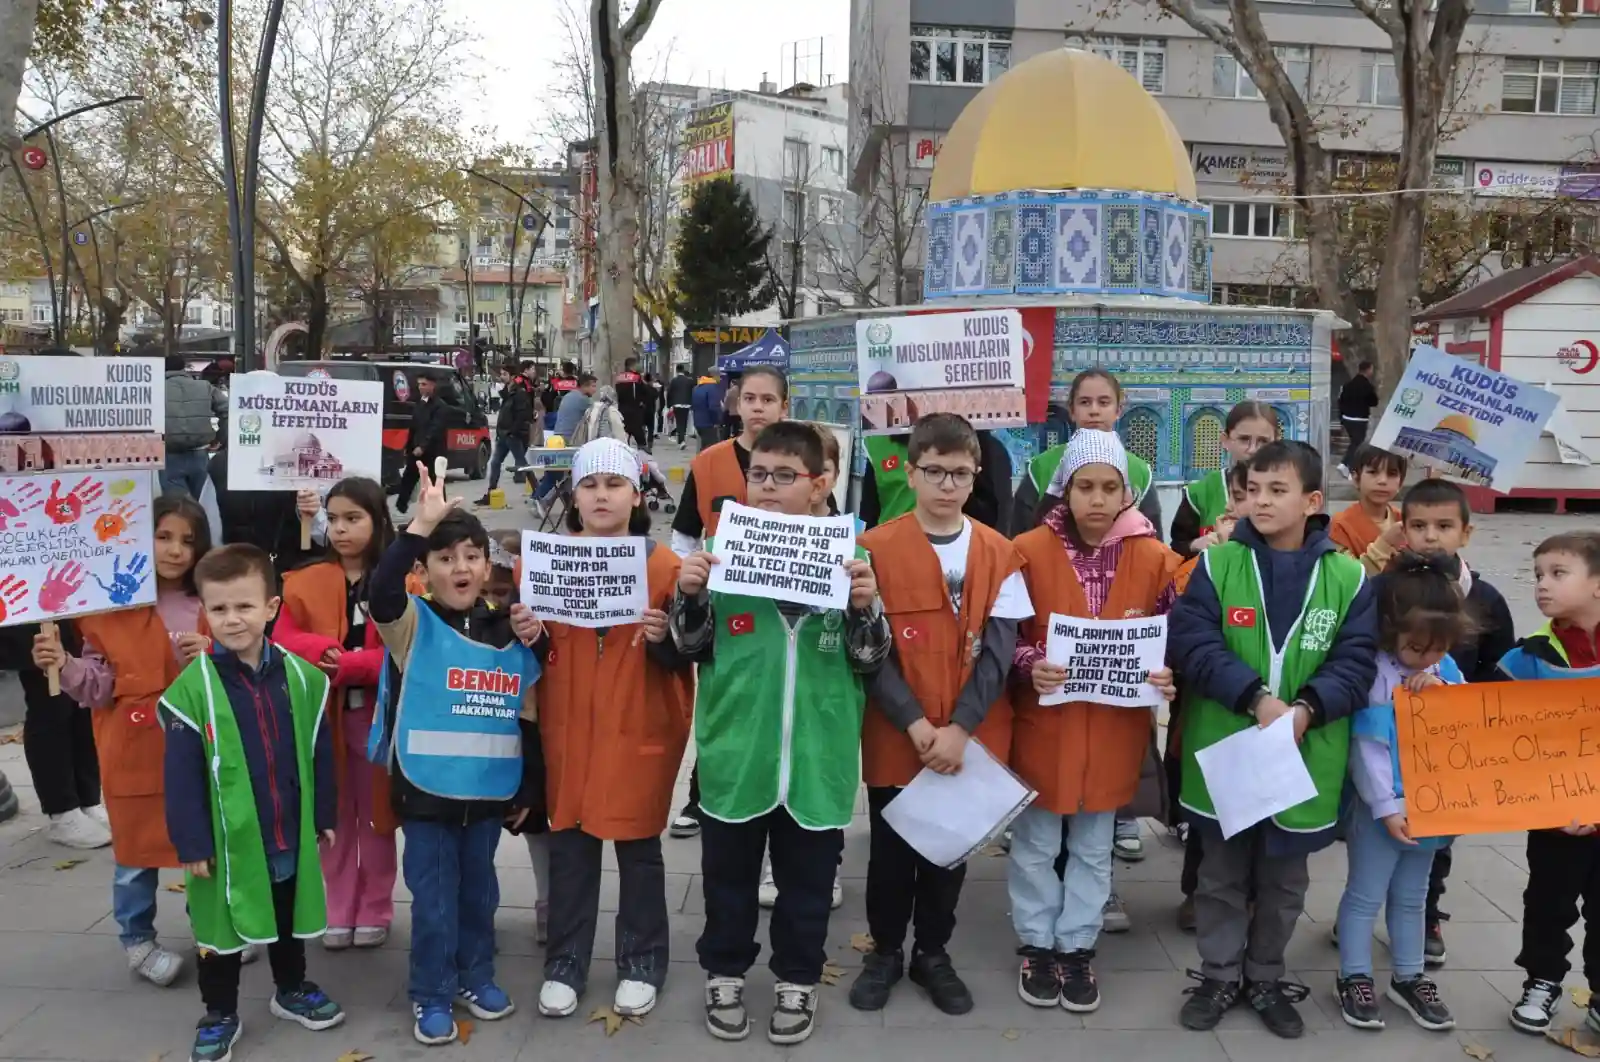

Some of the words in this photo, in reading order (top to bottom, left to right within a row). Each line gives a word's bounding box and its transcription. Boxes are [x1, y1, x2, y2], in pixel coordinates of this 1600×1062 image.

[1196, 152, 1247, 174] KAMER
[964, 315, 1009, 337] KUDÜS
[896, 338, 1010, 363] MÜSLÜMANLARIN
[107, 362, 152, 383] KUDÜS
[945, 360, 1011, 384] ŞEREFİDİR
[1451, 365, 1519, 399] KUDÜS
[31, 385, 152, 406] MÜSLÜMANLARIN
[285, 381, 338, 396] KUDÜS
[1415, 370, 1539, 423] MÜSLÜMANLARIN
[238, 394, 379, 414] MÜSLÜMANLARIN
[65, 408, 152, 428] NAMUSUDUR
[271, 411, 348, 429] İFFETİDİR
[729, 512, 805, 534] HAKLARIMIN
[530, 540, 592, 557] HAKLARIMIN
[724, 539, 799, 559] MİLYONDAN
[802, 551, 844, 566] FAZLA
[811, 538, 830, 550] 48
[731, 553, 786, 572] MÜLTECİ
[789, 562, 833, 581] ÇOCUK
[529, 570, 554, 584] DOĞU
[557, 574, 636, 587] TÜRKİSTAN'DA
[724, 569, 834, 597] BULUNMAKTADIR.
[598, 586, 632, 597] FAZLA
[531, 605, 572, 617] KAMPLARA
[564, 598, 598, 610] ÇOCUK
[1054, 622, 1124, 640] HAKLARIMIN
[1068, 655, 1141, 670] FİLİSTİN'DE
[447, 666, 521, 696] BENİM
[1064, 682, 1097, 696] ŞEHİT
[1100, 683, 1141, 698] EDİLDİ.
[465, 694, 506, 707] YAŞAMA
[451, 705, 493, 717] HAKKIM
[495, 709, 516, 719] VAR!
[1412, 741, 1442, 774] Ne
[1448, 741, 1509, 771] Olursa
[1513, 734, 1567, 762] Olsun
[1415, 782, 1479, 813] Olmak
[1493, 778, 1541, 806] Benim
